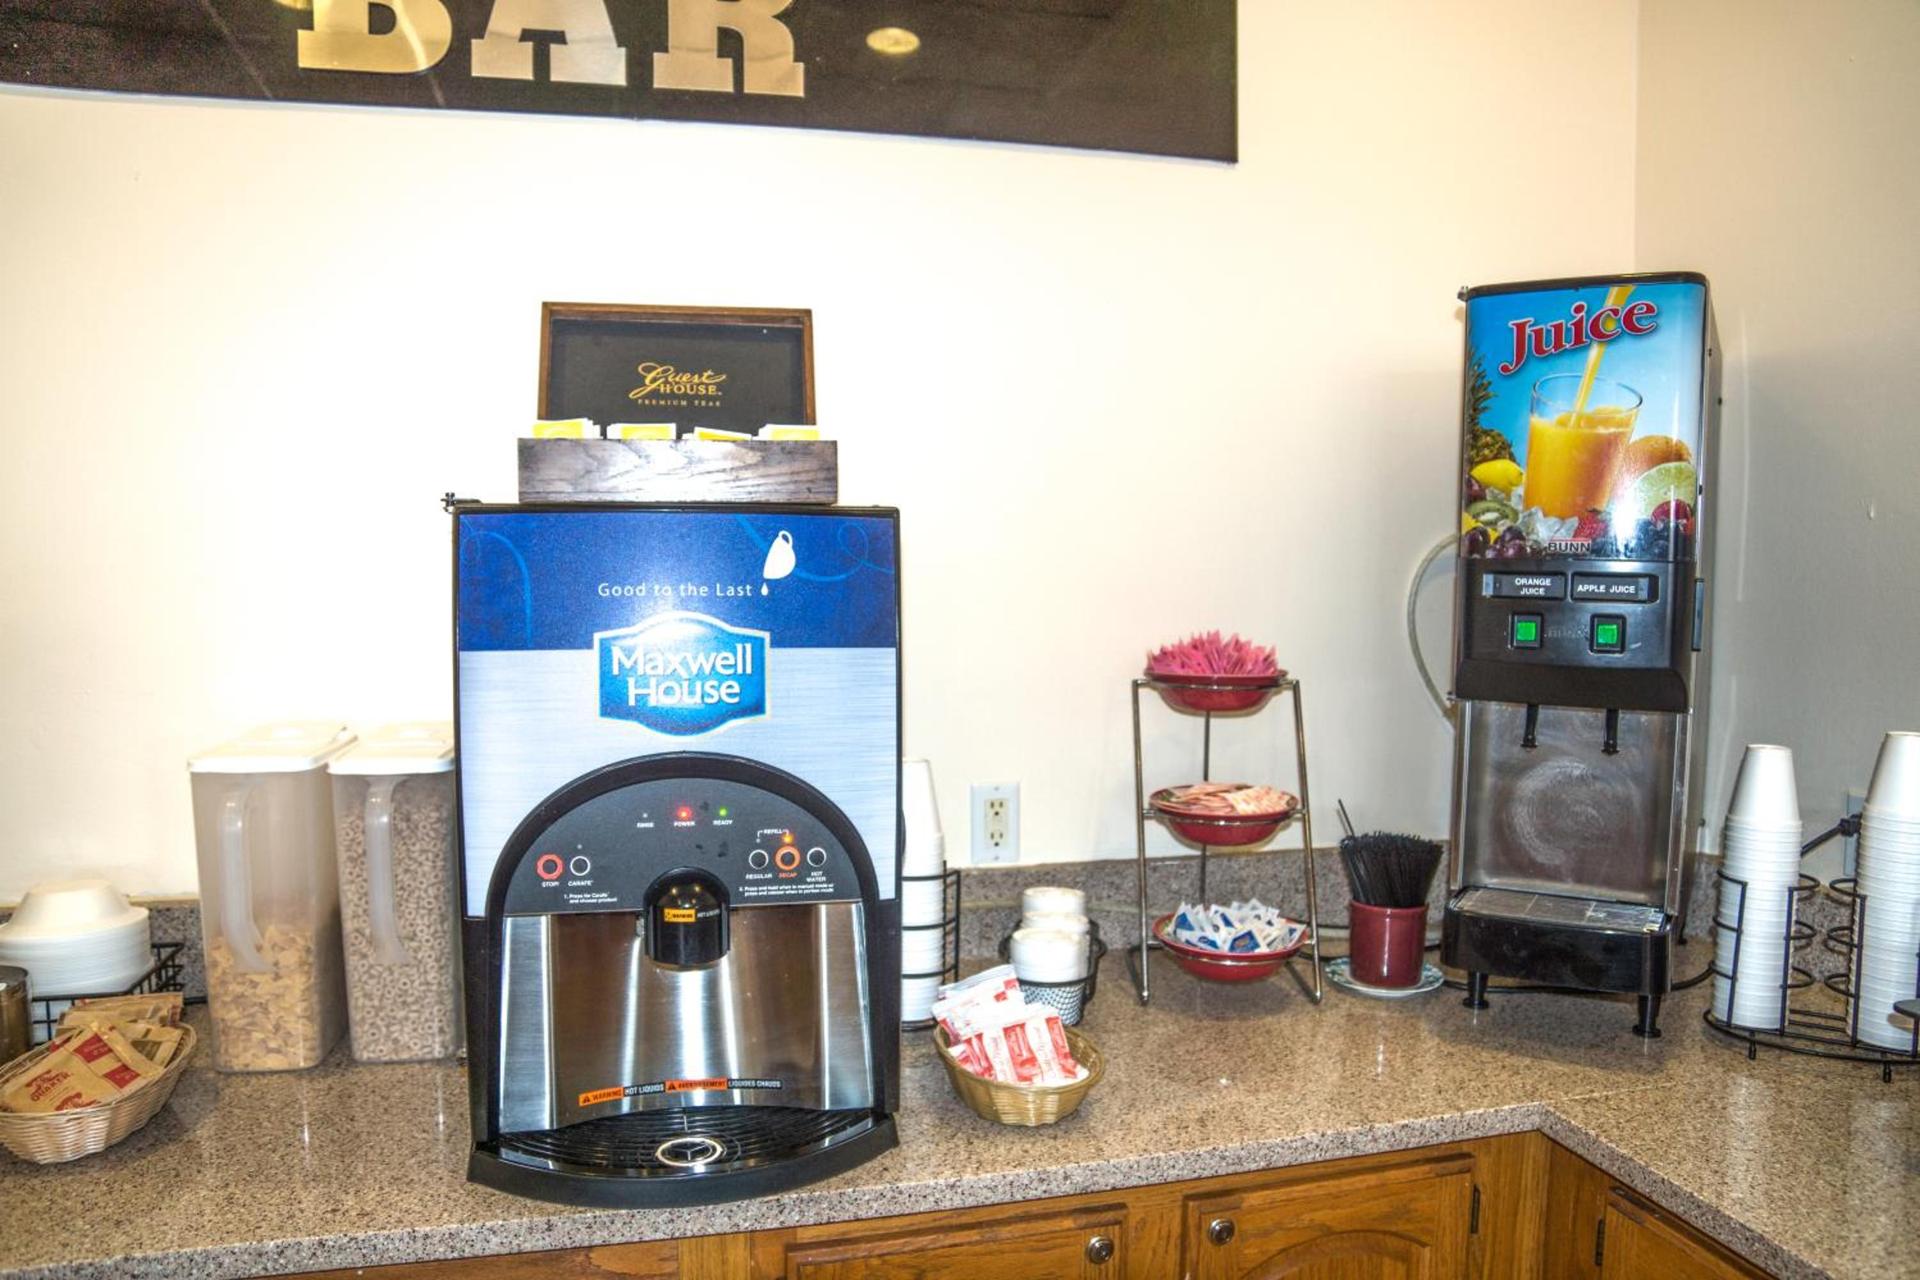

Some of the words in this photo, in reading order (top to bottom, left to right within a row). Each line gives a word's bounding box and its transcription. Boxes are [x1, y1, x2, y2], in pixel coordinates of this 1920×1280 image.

[296, 0, 805, 98] BAR
[1499, 301, 1658, 375] Juice
[628, 362, 728, 400] Guest
[660, 384, 718, 396] HOUSE
[1547, 541, 1591, 553] BUNN
[1514, 577, 1551, 587] ORANGE
[1576, 584, 1606, 593] APPLE
[1609, 585, 1636, 594] JUICE
[597, 583, 647, 597] Good
[654, 584, 673, 597] to
[679, 583, 710, 597] the
[715, 583, 753, 597] Last
[1520, 587, 1545, 595] JUICE
[611, 643, 753, 678] Maxwell
[627, 677, 741, 707] House
[624, 1086, 637, 1096] HOT
[638, 1082, 665, 1095] LIQUIDS
